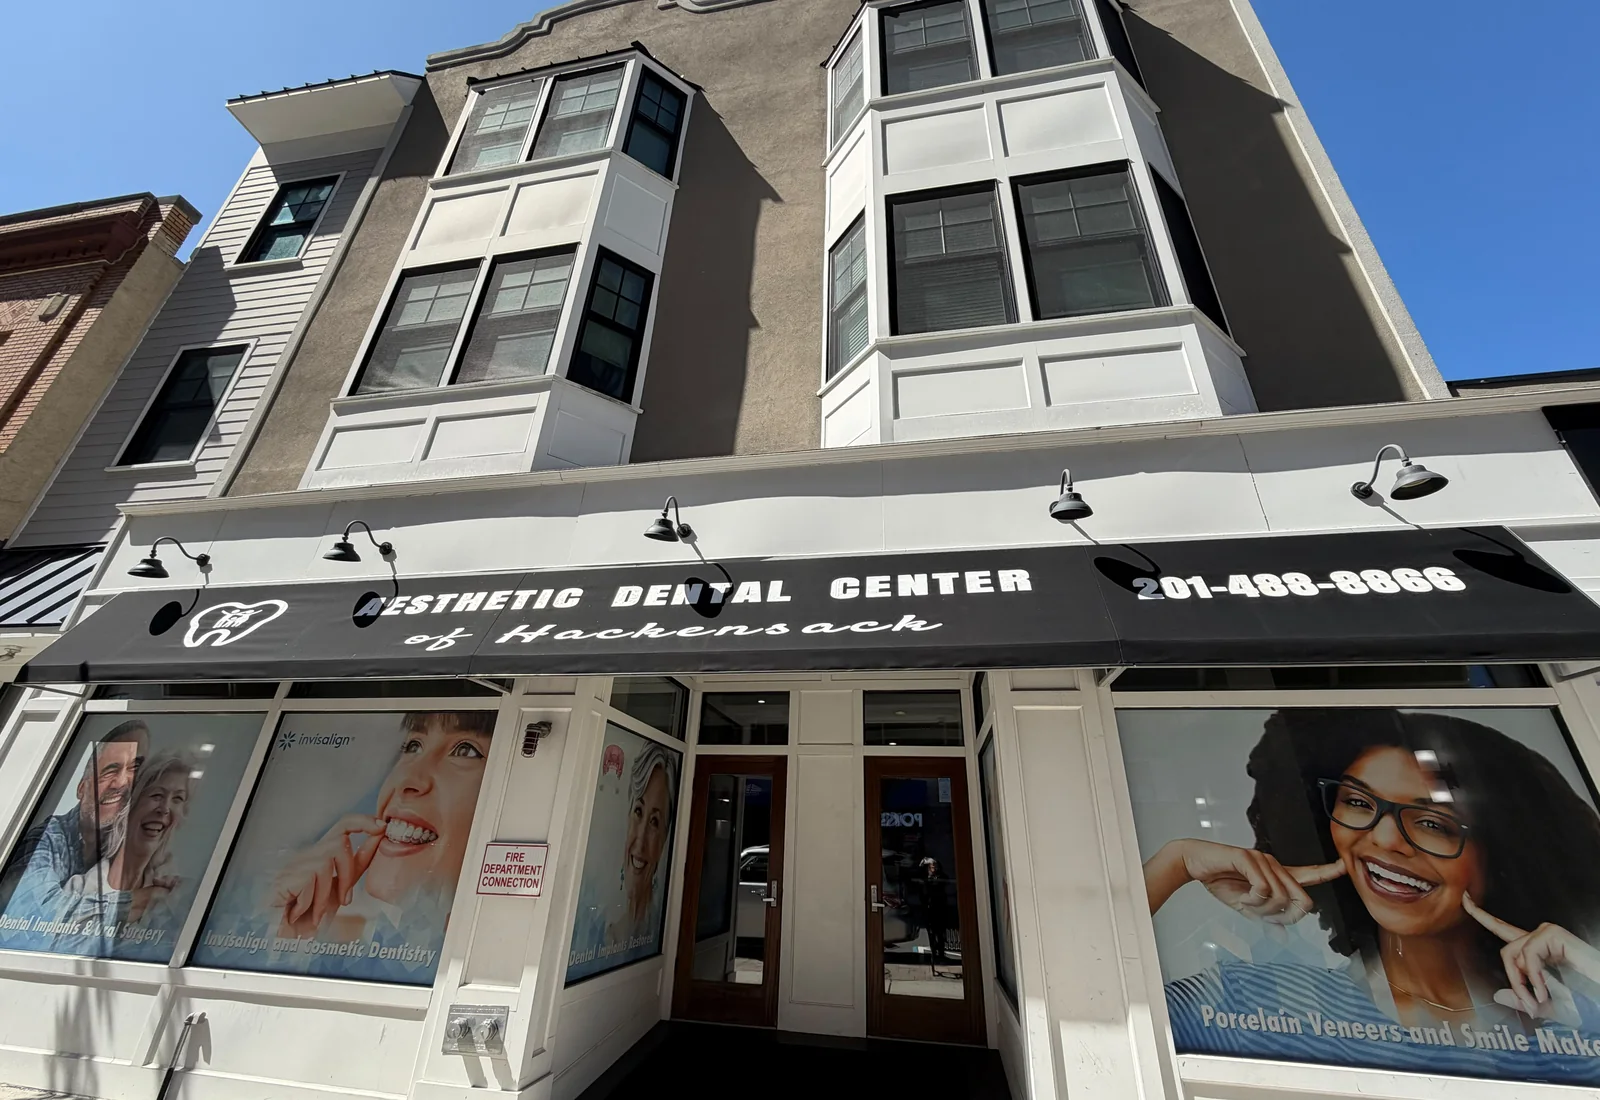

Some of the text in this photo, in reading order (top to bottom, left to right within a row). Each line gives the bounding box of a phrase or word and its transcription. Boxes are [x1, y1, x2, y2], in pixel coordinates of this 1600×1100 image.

[354, 569, 1033, 617] AESTHETIC DENTAL CENTER
[1132, 567, 1467, 600] 201-488-8866
[404, 614, 943, 651] of Hackensack
[298, 733, 351, 748] invisalign
[483, 863, 542, 875] DEPARTMENT
[505, 852, 525, 862] FIRE
[482, 876, 539, 888] CONNECTION
[0, 914, 166, 945] Dental Implants & Oral Surgery
[204, 929, 437, 968] Invisalign and Cosmetic Dentistry
[568, 944, 597, 967] Dental
[597, 939, 628, 959] Implants
[1201, 1004, 1304, 1035] Porcelain
[1306, 1011, 1402, 1043] Veneers
[1409, 1020, 1456, 1047] and
[1462, 1024, 1530, 1052] Smile
